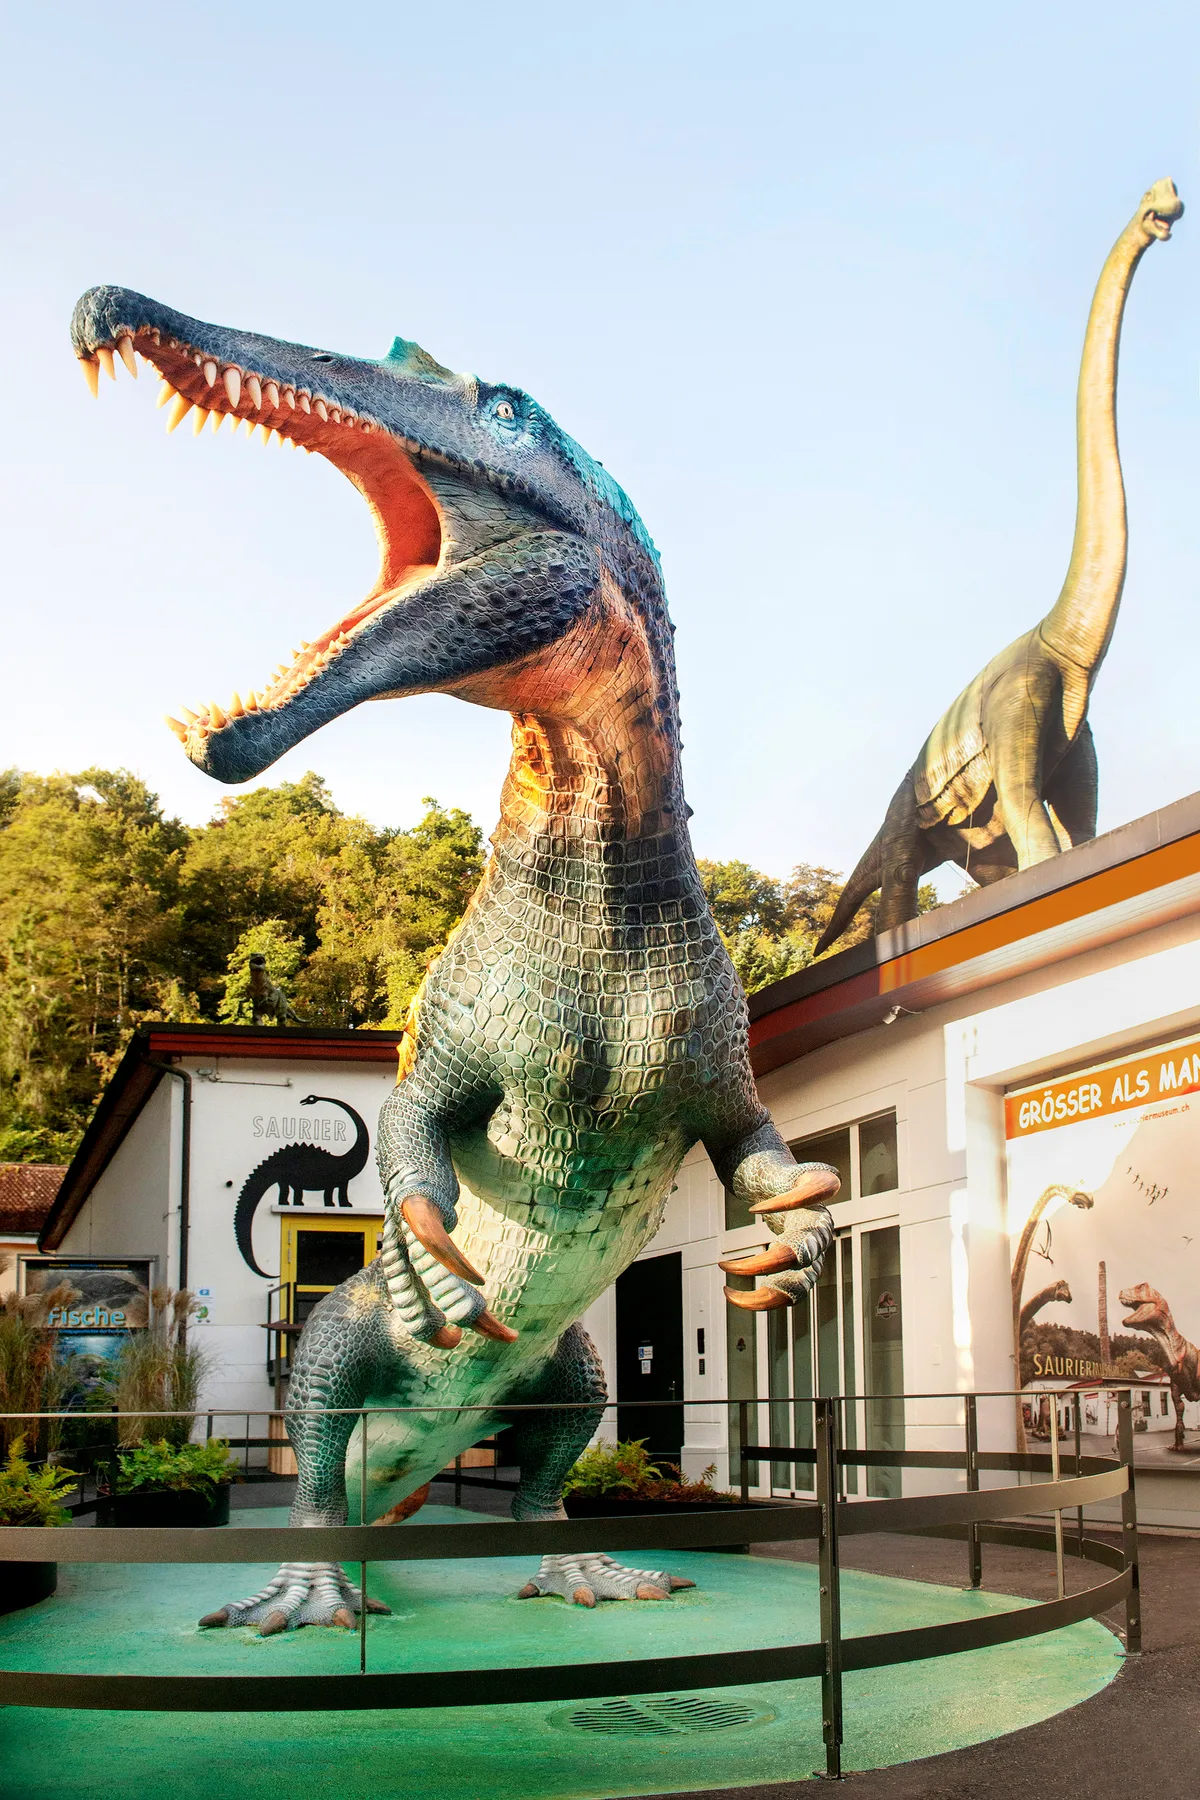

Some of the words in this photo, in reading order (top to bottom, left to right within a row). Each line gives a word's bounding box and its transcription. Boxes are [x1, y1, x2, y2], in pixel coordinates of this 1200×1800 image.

[1018, 1083, 1102, 1129] GRÖSSER
[1111, 1069, 1150, 1105] ALS
[252, 1115, 347, 1142] SAURIER
[47, 1305, 125, 1325] Fische
